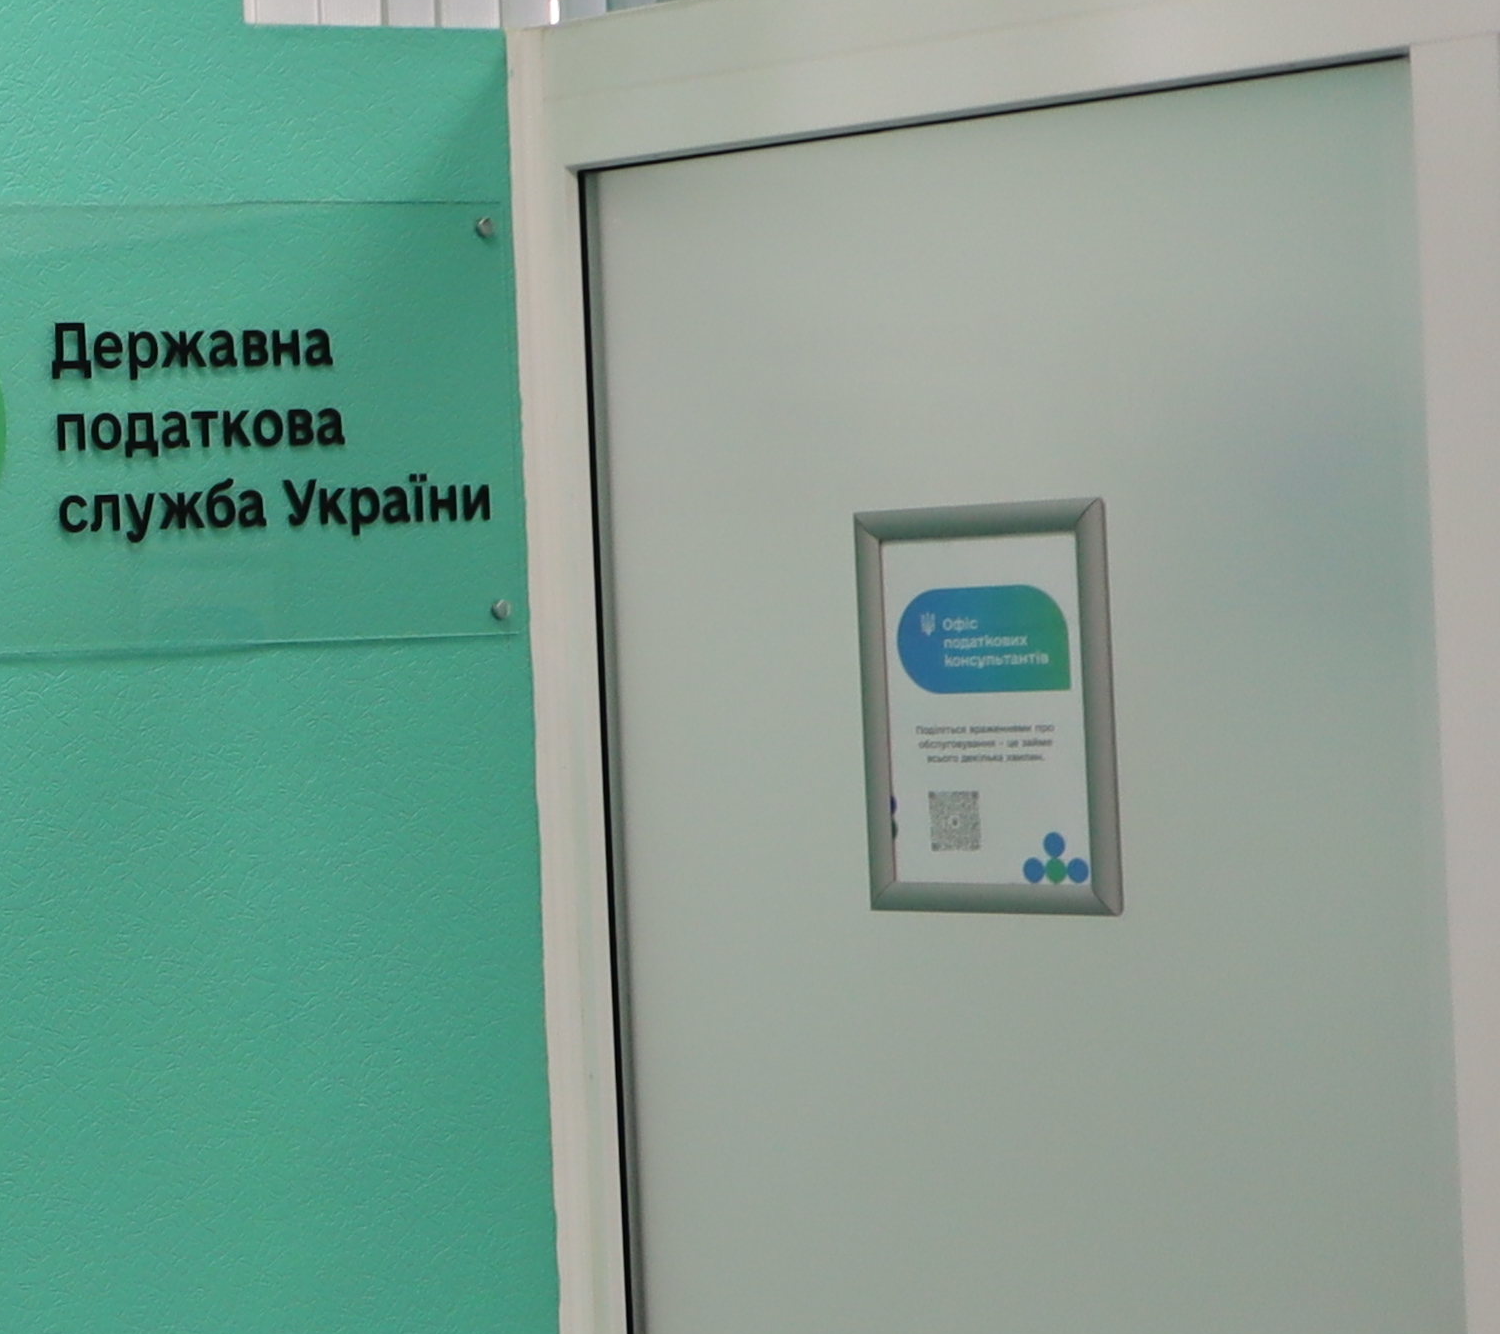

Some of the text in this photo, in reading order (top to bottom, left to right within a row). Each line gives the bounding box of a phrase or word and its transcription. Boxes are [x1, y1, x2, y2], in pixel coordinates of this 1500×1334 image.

[52, 323, 333, 381] Державна
[57, 408, 345, 458] податкова
[59, 474, 490, 543] служба України
[941, 615, 979, 633] Офіс
[943, 635, 1028, 649] податкових
[944, 652, 1049, 668] консультантів
